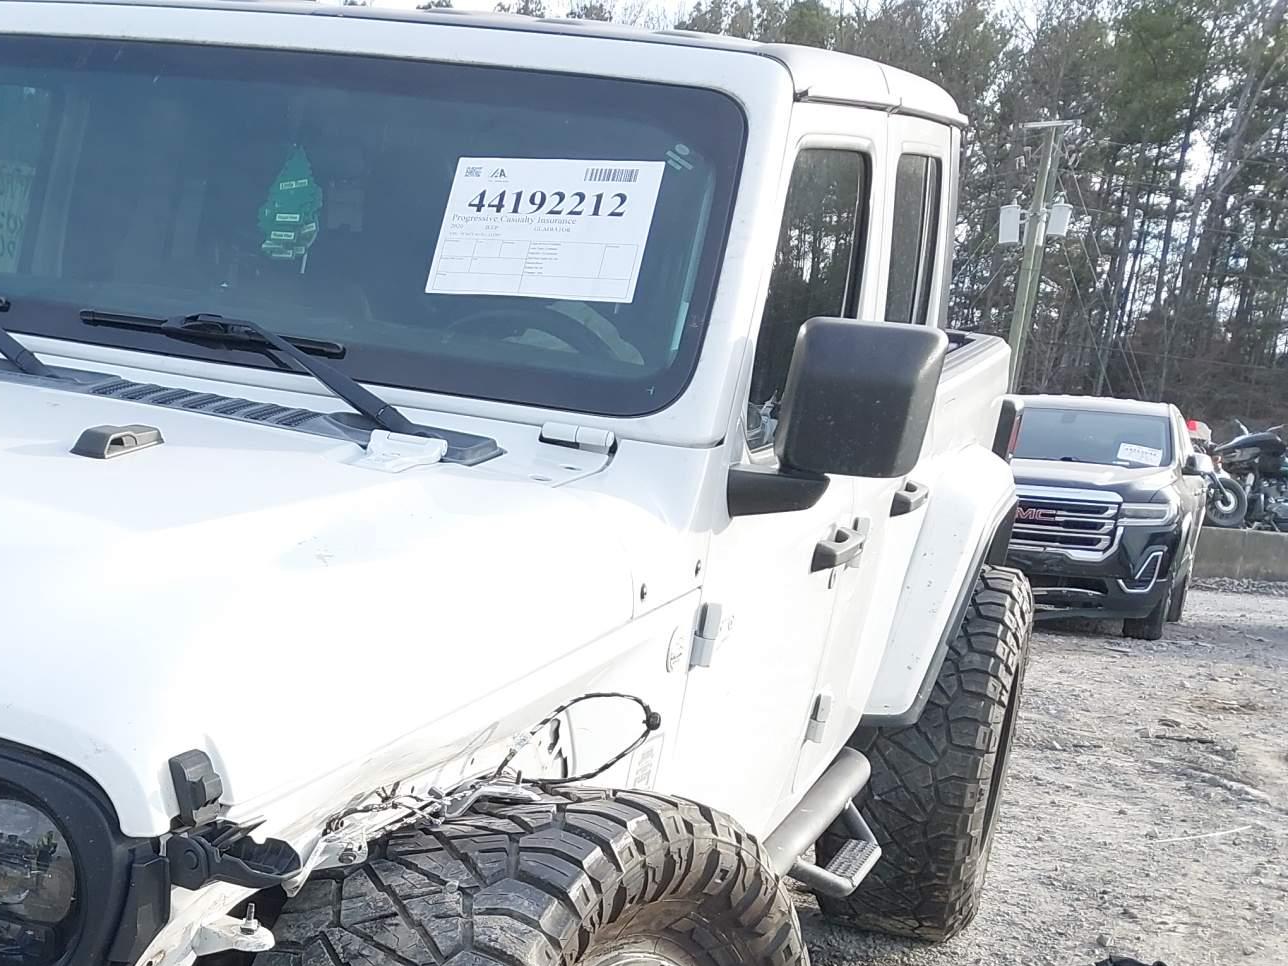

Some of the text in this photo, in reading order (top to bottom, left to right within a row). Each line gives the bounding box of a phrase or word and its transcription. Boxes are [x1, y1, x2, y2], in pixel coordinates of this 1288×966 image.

[468, 189, 628, 217] 44192212
[452, 214, 577, 225] Progressive Casualty Insurance
[1015, 508, 1056, 521] MC
